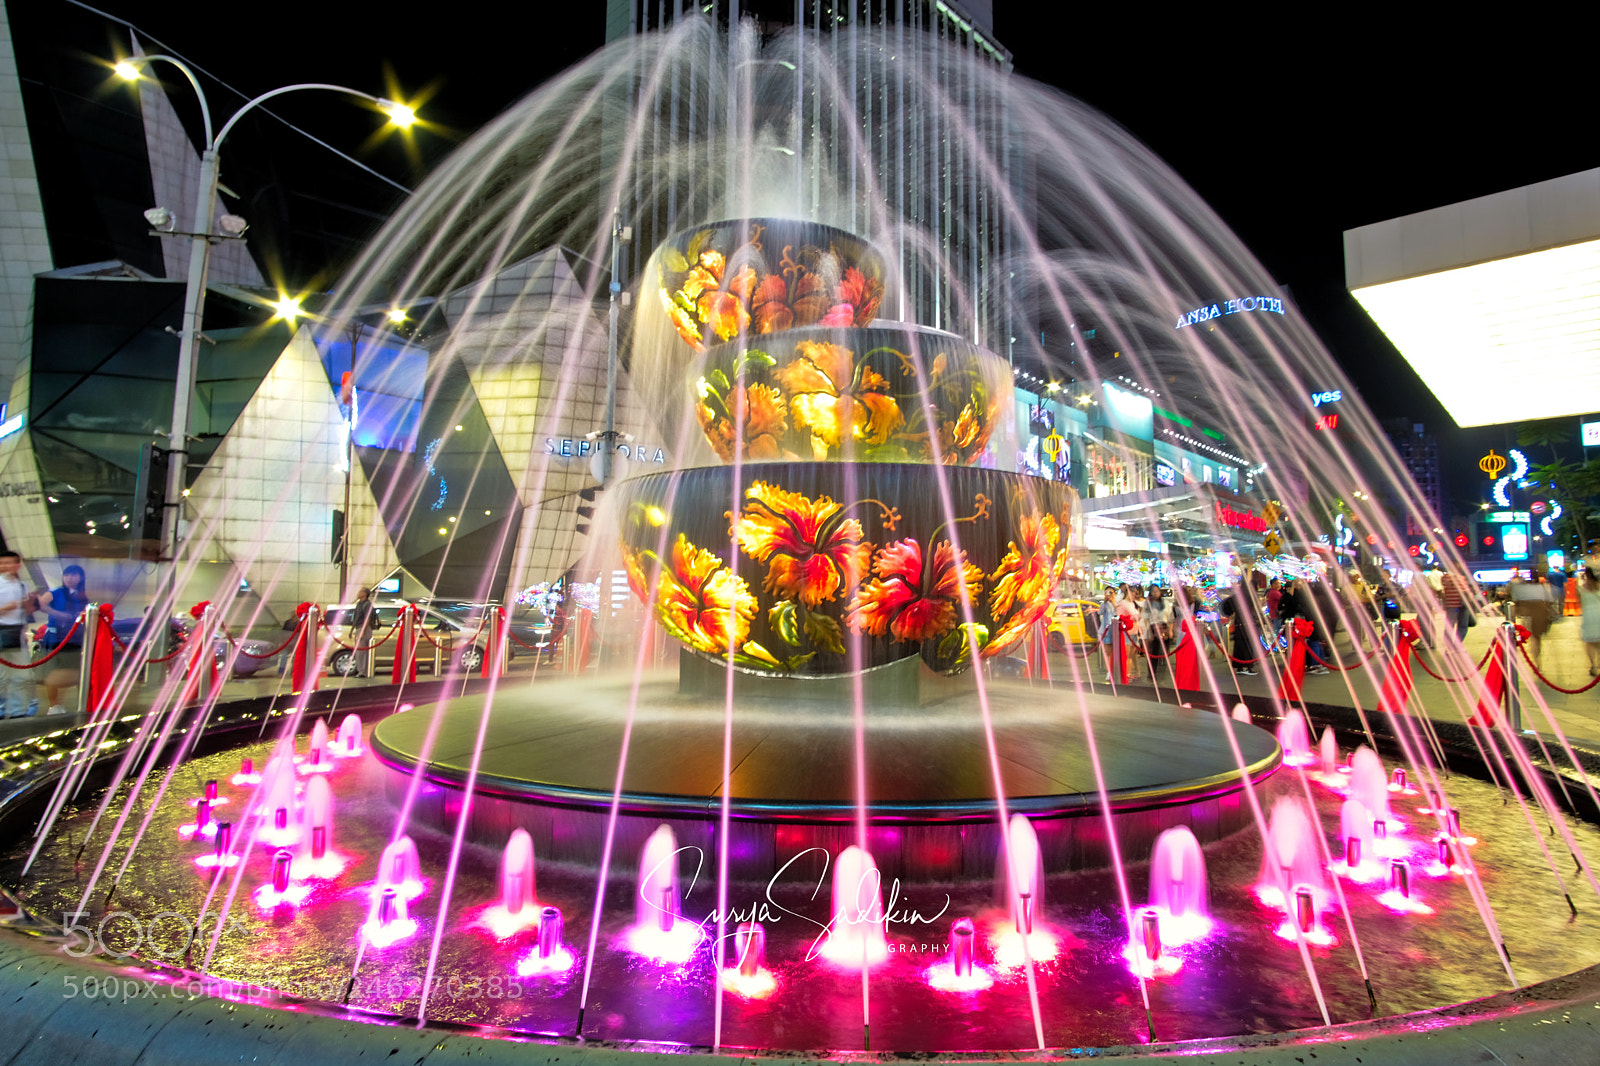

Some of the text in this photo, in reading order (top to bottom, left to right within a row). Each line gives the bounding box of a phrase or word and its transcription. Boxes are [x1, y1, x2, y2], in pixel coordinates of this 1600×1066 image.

[1175, 296, 1285, 329] ANSA HOTEL
[1311, 390, 1342, 408] yes
